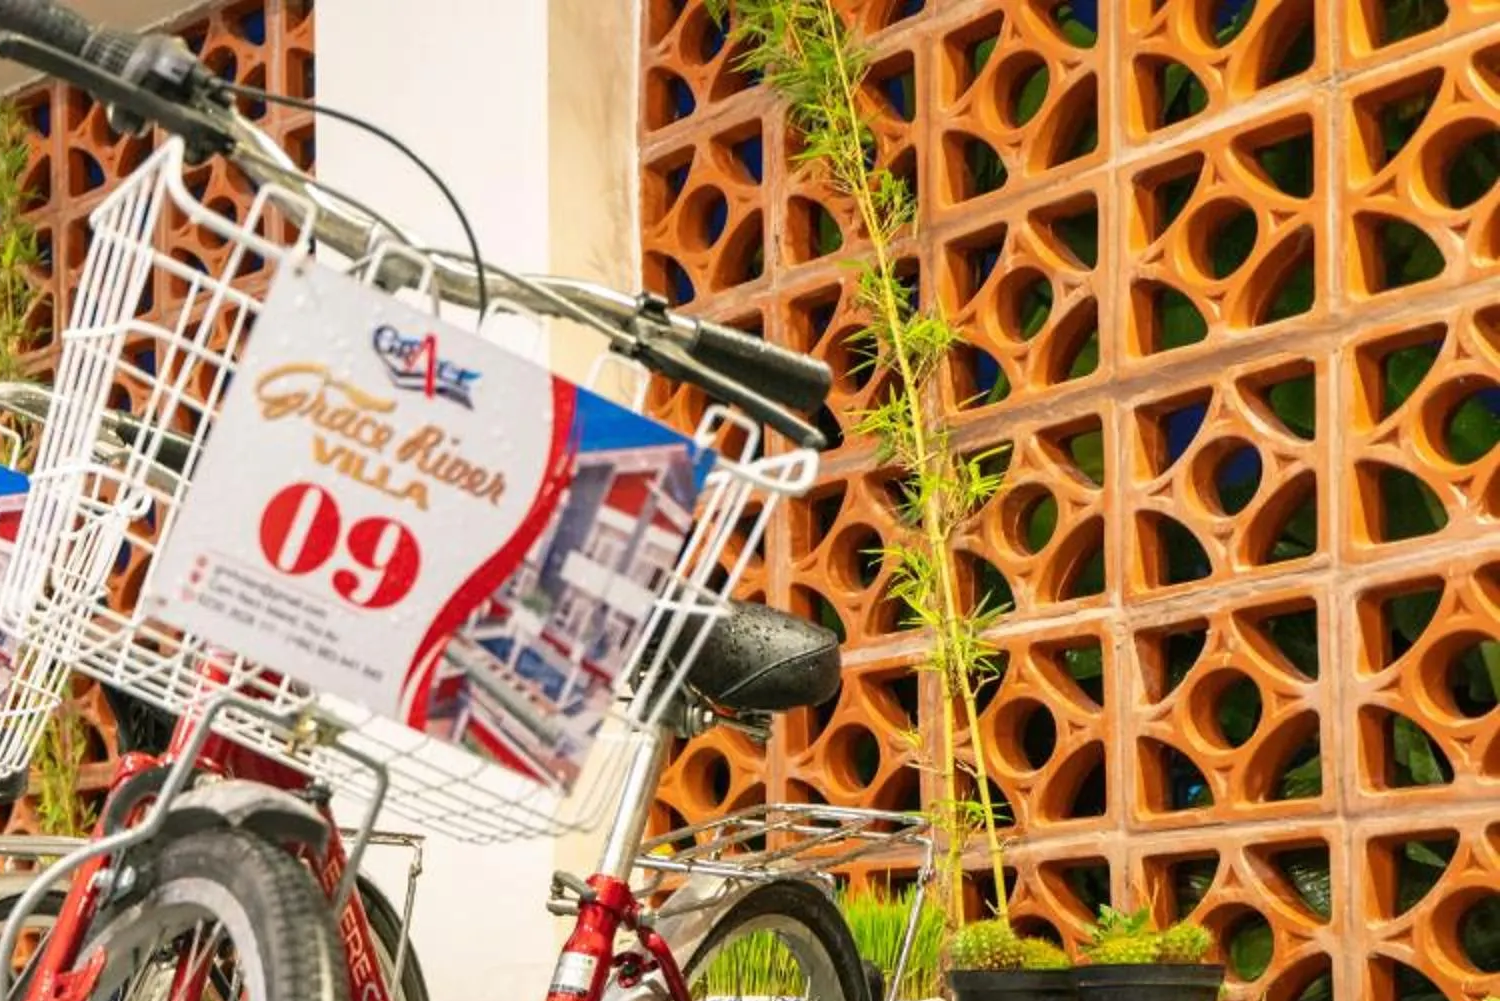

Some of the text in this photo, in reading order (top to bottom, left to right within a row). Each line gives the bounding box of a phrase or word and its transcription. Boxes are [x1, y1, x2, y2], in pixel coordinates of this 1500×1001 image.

[255, 362, 507, 506] Grace River
[311, 434, 429, 511] VILLA
[258, 482, 421, 610] 09
